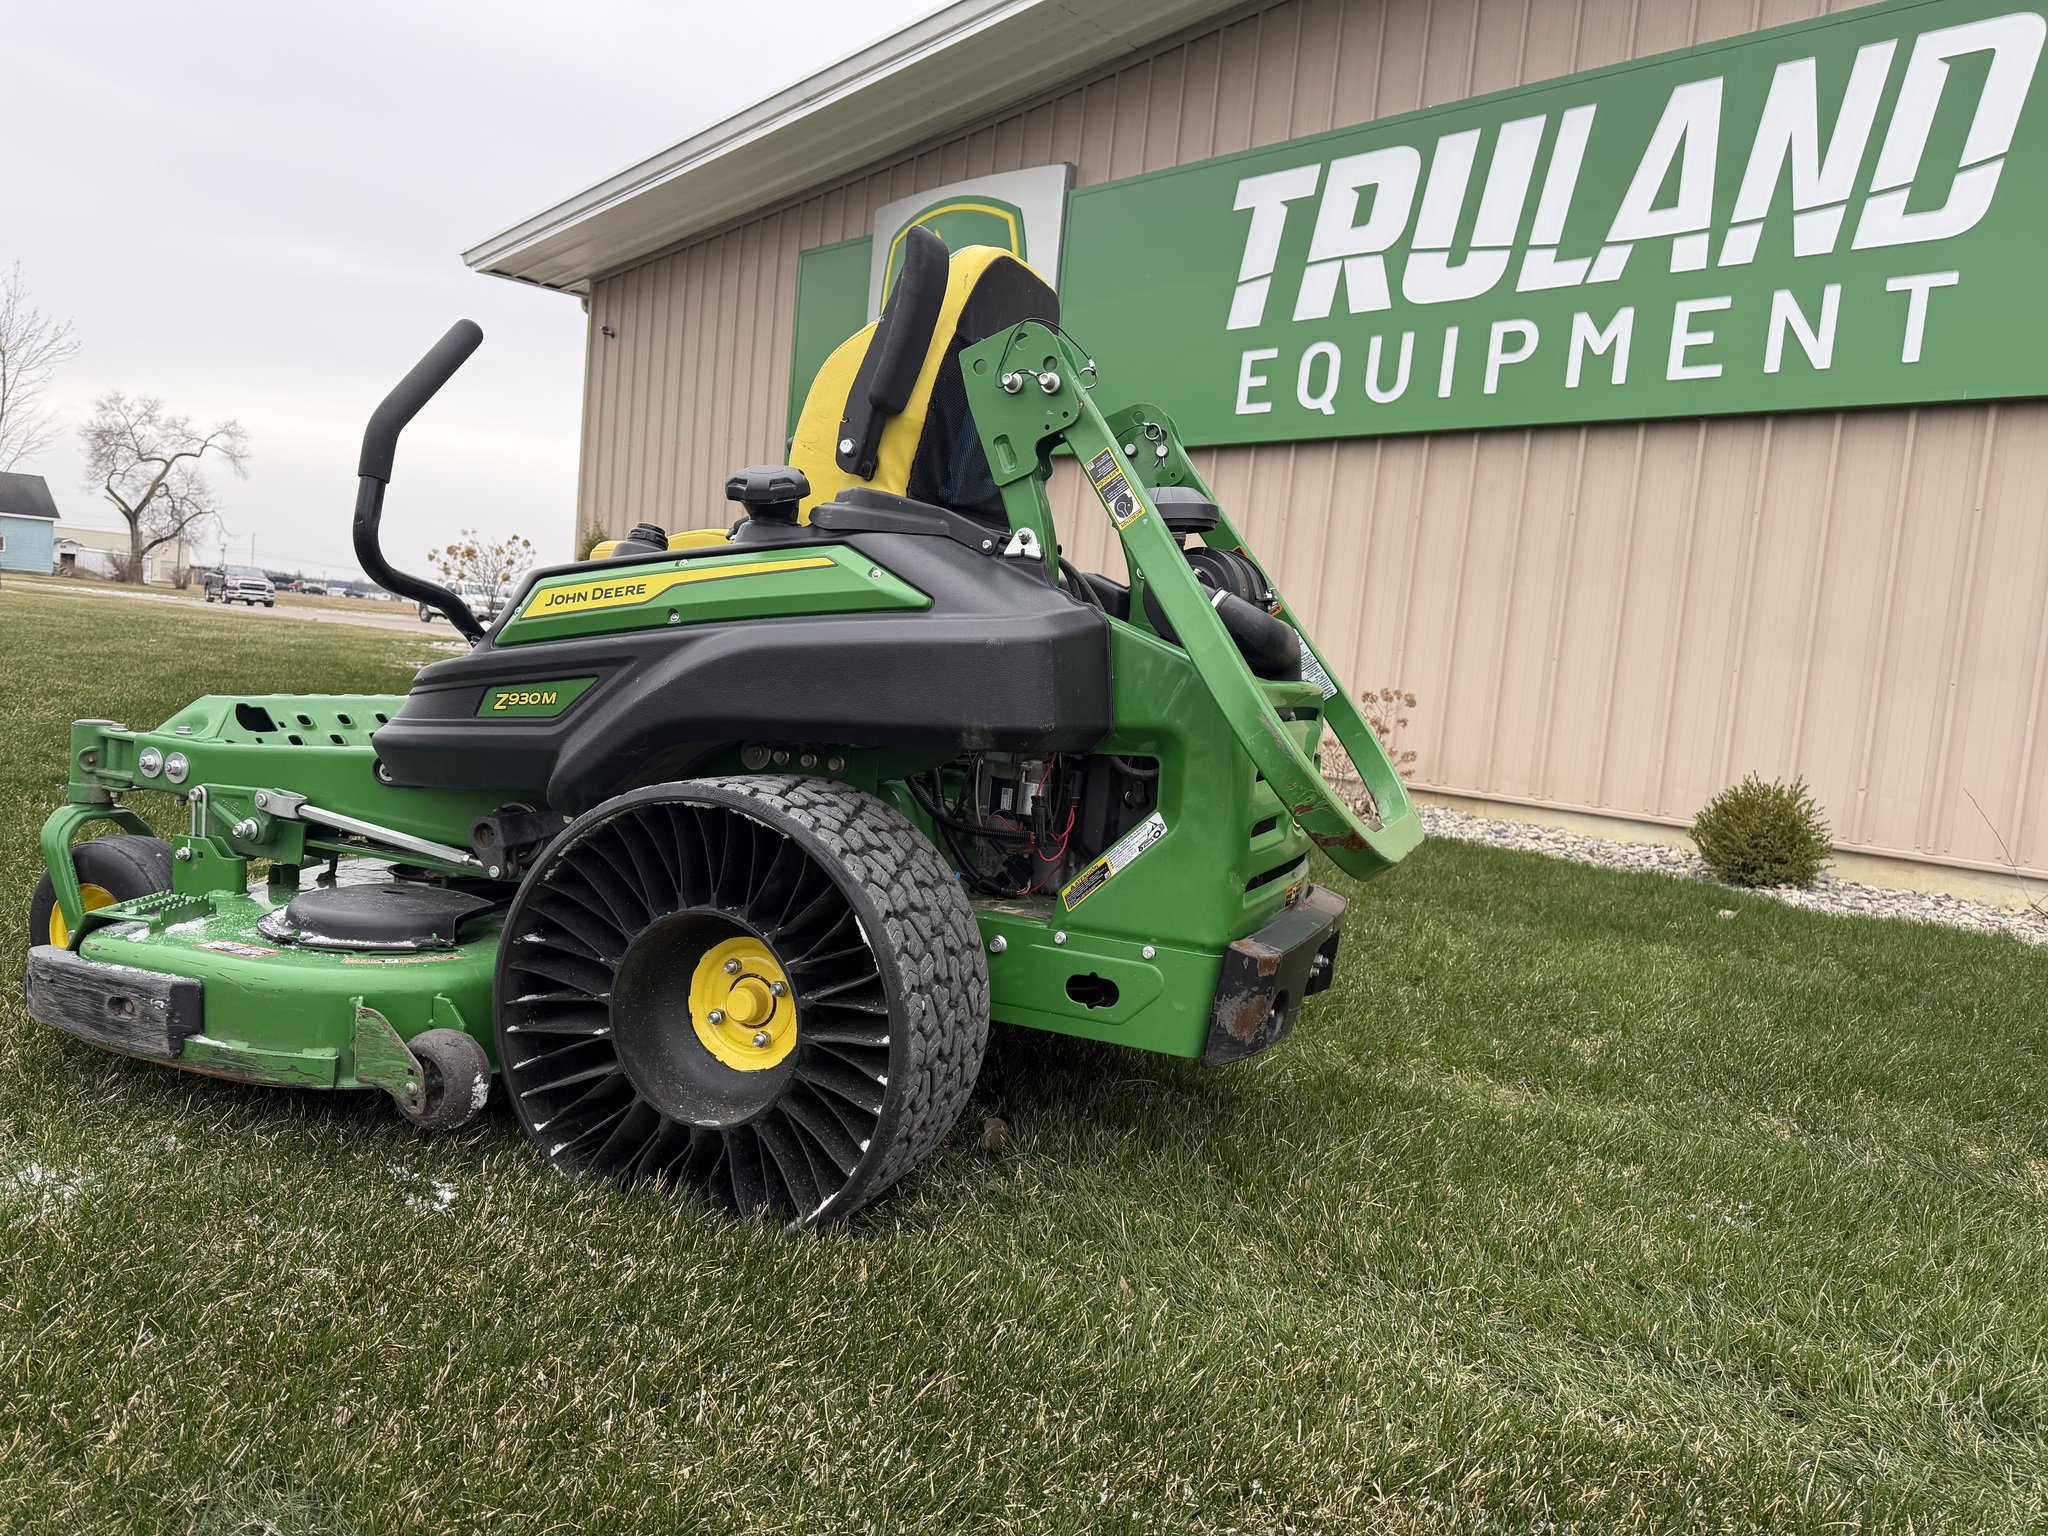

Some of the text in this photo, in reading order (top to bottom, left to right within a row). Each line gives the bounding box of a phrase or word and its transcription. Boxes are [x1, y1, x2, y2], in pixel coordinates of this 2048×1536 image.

[1226, 12, 2047, 330] TRULAND
[1234, 271, 1960, 415] EQUIPMENT
[1120, 513, 1140, 529] CAUTION
[545, 584, 647, 607] JOHN DEERE
[493, 691, 558, 711] Z930M
